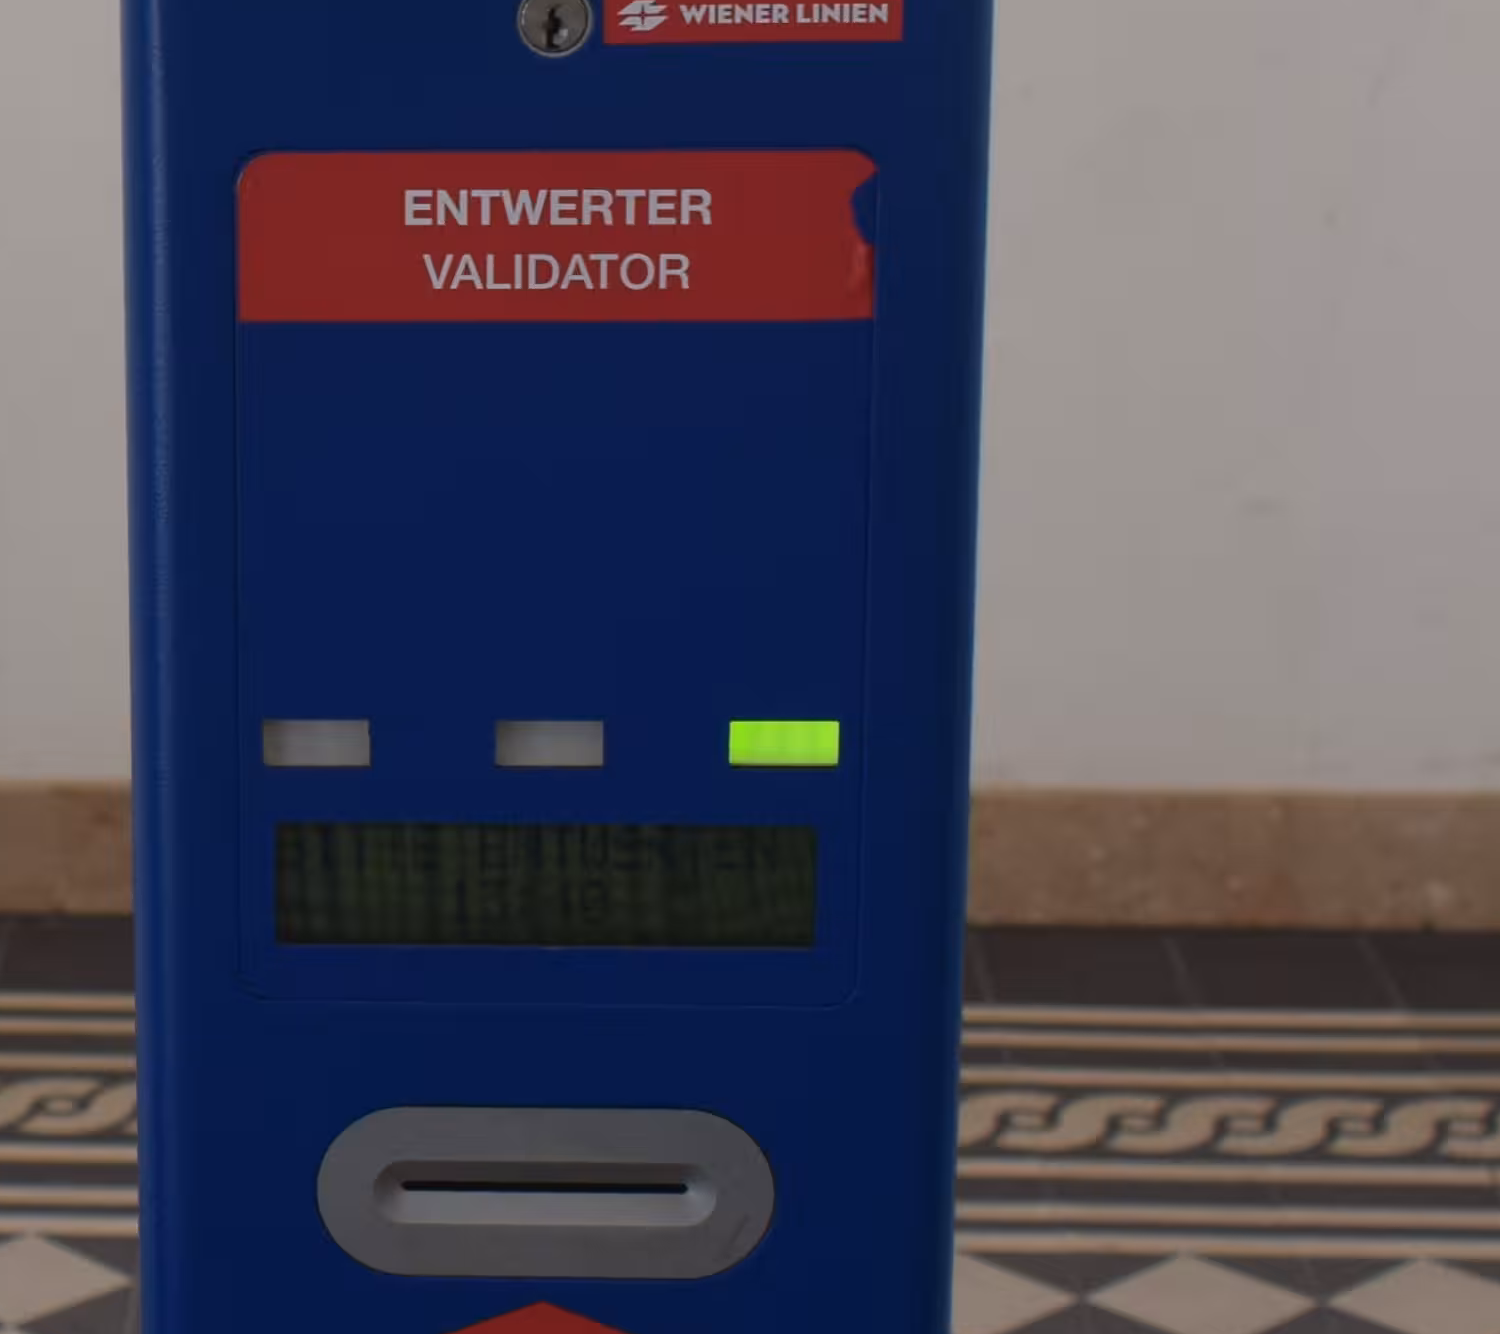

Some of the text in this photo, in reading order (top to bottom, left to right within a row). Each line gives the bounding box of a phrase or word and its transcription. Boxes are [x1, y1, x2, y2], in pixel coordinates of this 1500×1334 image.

[679, 2, 889, 25] WIENER LINIEN
[403, 188, 713, 227] ENTWERTER
[422, 252, 690, 291] VALIDATOR
